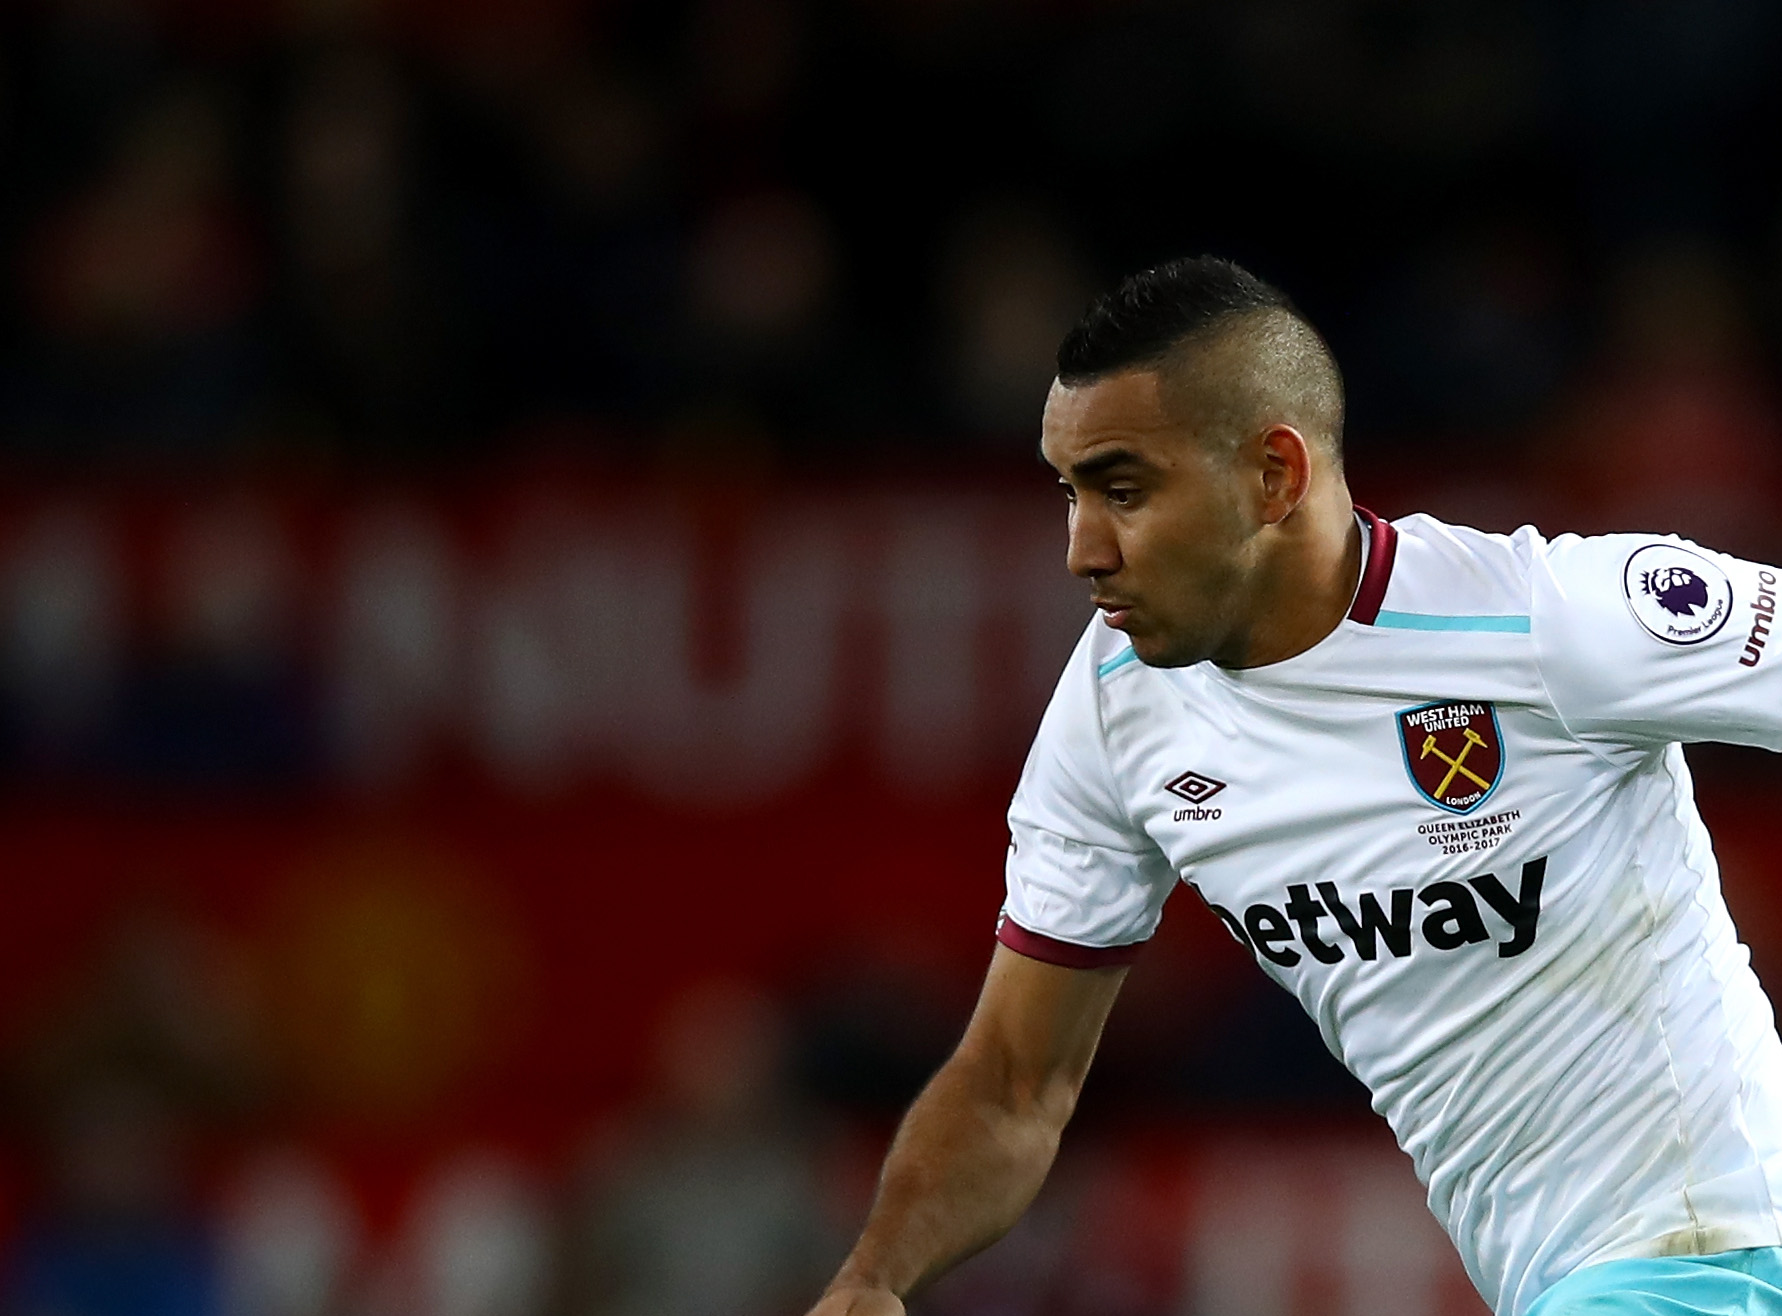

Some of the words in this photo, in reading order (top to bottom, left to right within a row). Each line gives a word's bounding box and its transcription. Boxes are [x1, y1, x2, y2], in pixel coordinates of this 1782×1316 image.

[1738, 570, 1777, 668] umbro
[1406, 708, 1445, 728] WEST
[1449, 704, 1485, 720] HAM
[1424, 715, 1470, 733] UNITED
[1446, 791, 1482, 806] LONDON
[1173, 805, 1222, 822] umbro
[1417, 822, 1456, 836] QUEEN
[1458, 809, 1521, 831] ELIZABETH
[1428, 830, 1478, 846] OLYMPIC
[1482, 823, 1513, 839] PARK
[1442, 838, 1501, 855] 2016-2017
